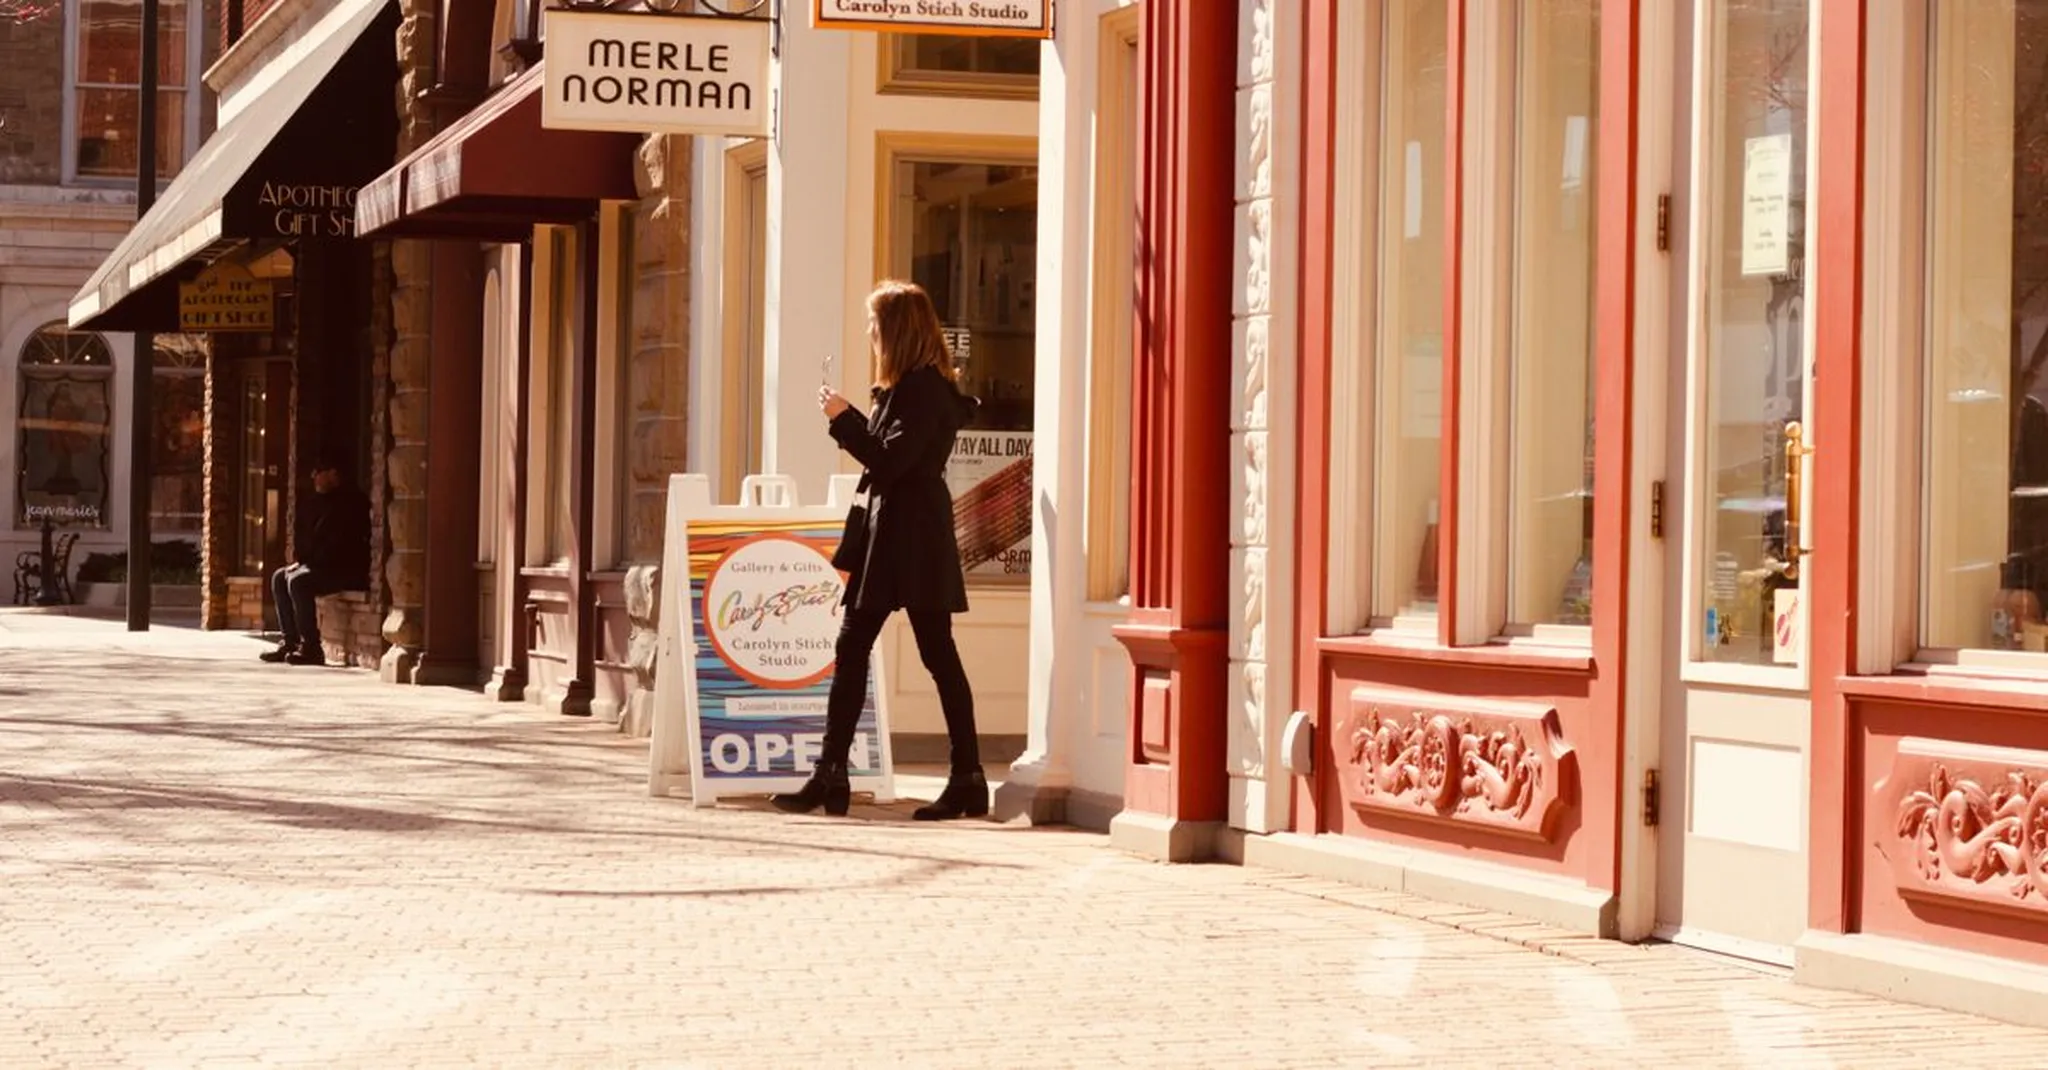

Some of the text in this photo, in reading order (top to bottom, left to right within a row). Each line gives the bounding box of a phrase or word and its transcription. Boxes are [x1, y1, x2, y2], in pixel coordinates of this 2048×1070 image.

[836, 0, 1029, 20] Carolyn Stich Studio
[588, 39, 729, 72] MERLE
[562, 74, 751, 110] NORMAN
[259, 181, 358, 207] APOTHEC
[275, 208, 355, 236] GIFT SH
[184, 312, 221, 324] GIFT
[943, 333, 970, 349] EE
[954, 436, 977, 455] TAY
[978, 437, 1003, 456] ALL
[731, 562, 823, 574] Gallery & Gifts
[731, 638, 832, 651] Carolyn Stich
[759, 654, 808, 667] Studio
[710, 733, 870, 774] OPEN
